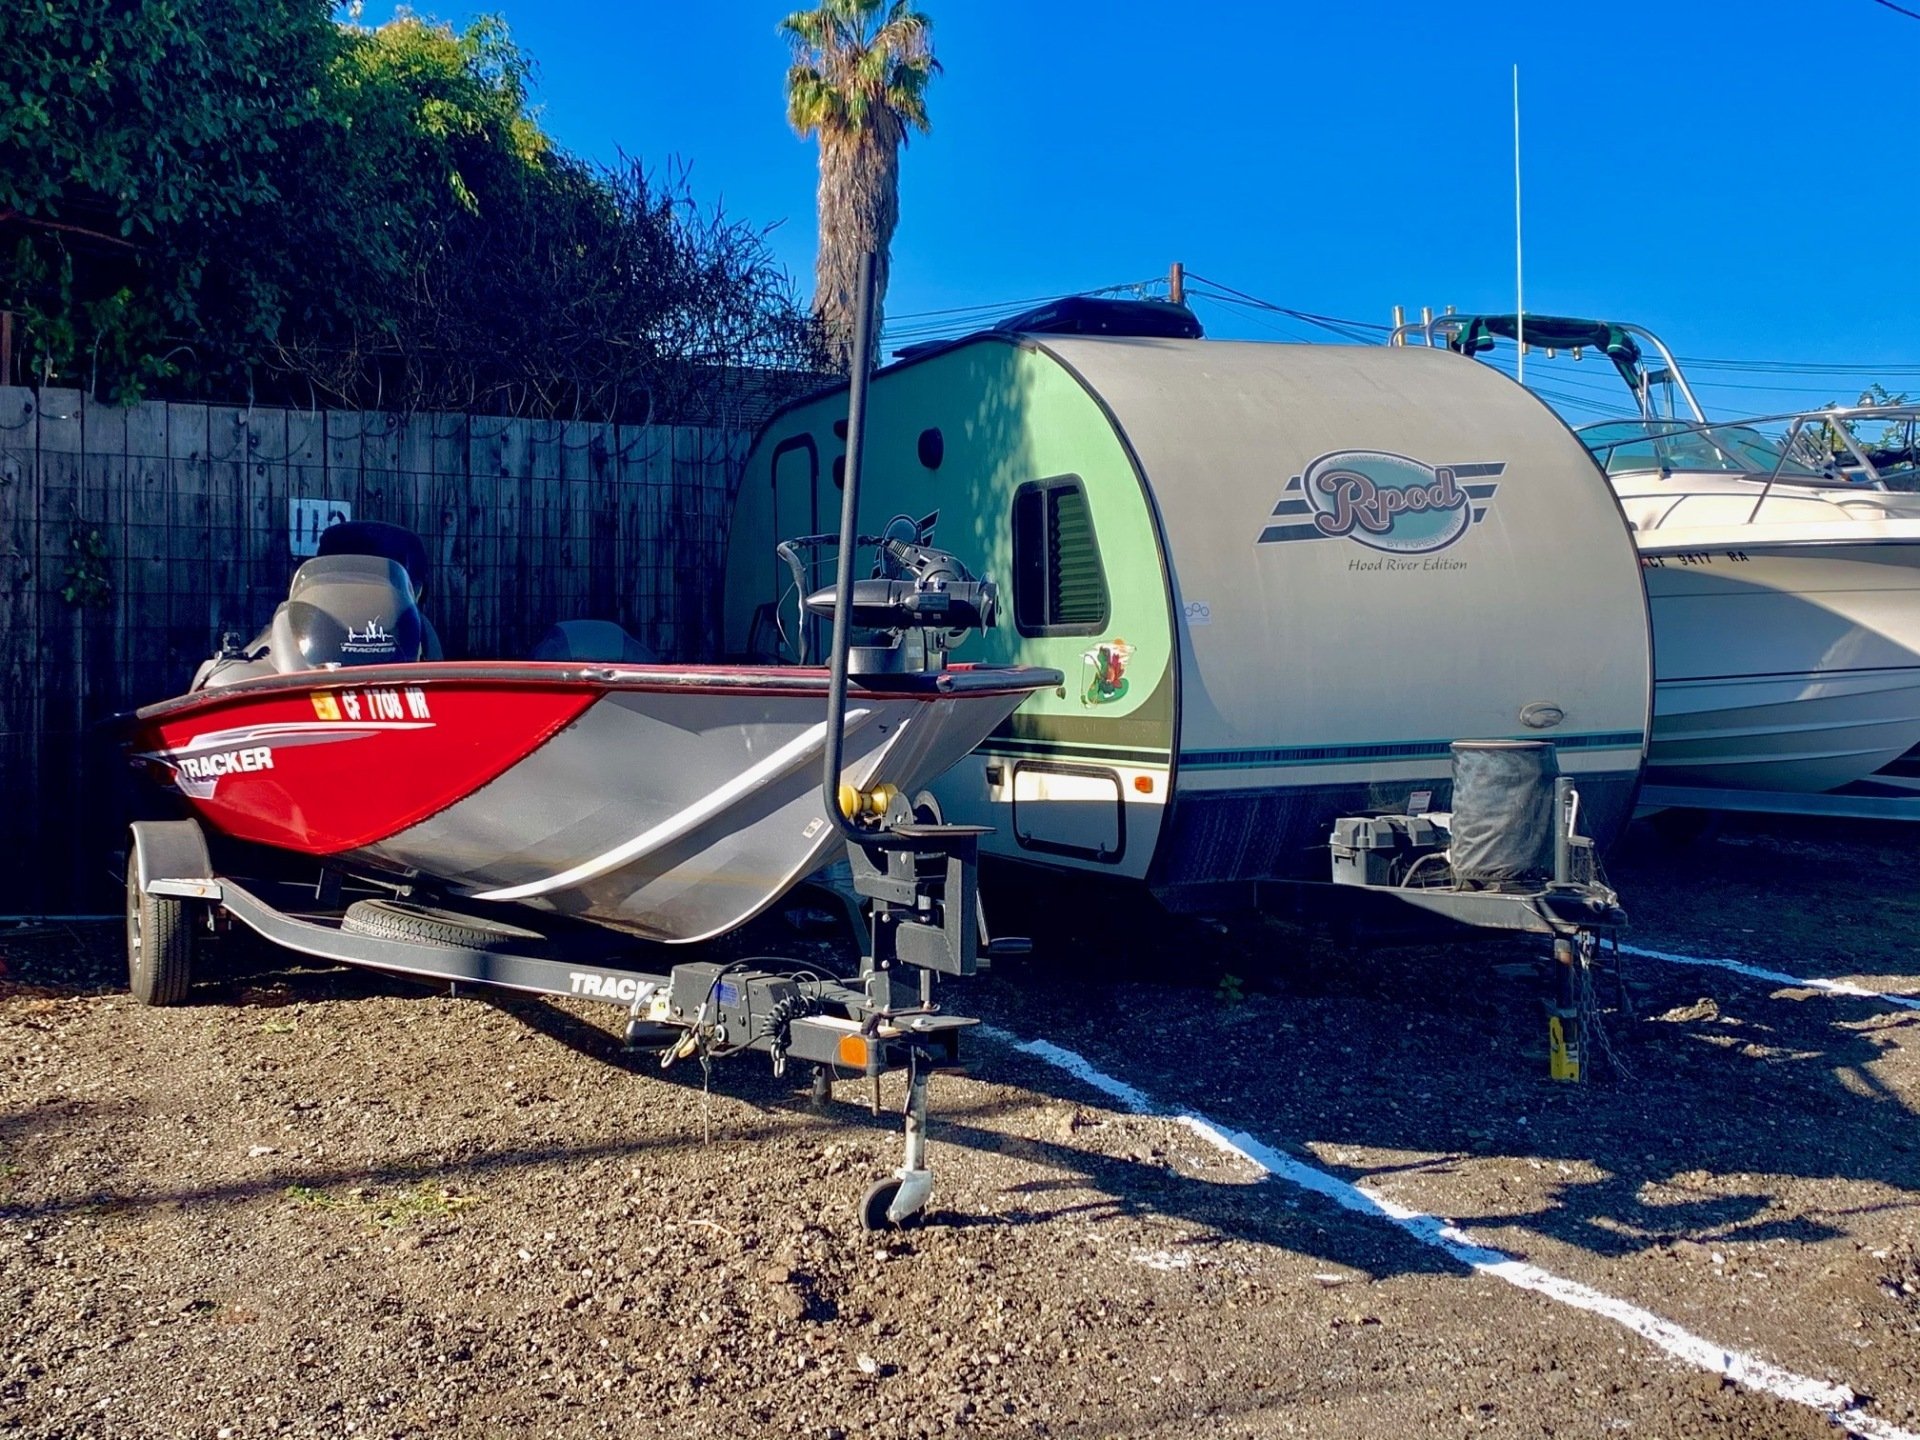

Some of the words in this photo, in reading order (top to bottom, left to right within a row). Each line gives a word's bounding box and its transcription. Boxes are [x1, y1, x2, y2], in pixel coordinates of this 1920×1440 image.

[1348, 557, 1383, 571] Hood
[1386, 558, 1419, 571] River
[1423, 557, 1467, 571] Edition
[1647, 555, 1666, 568] CF
[1726, 551, 1750, 562] RA
[342, 690, 361, 720] CF
[177, 746, 275, 777] TRACKER
[569, 972, 654, 1003] TRACK
